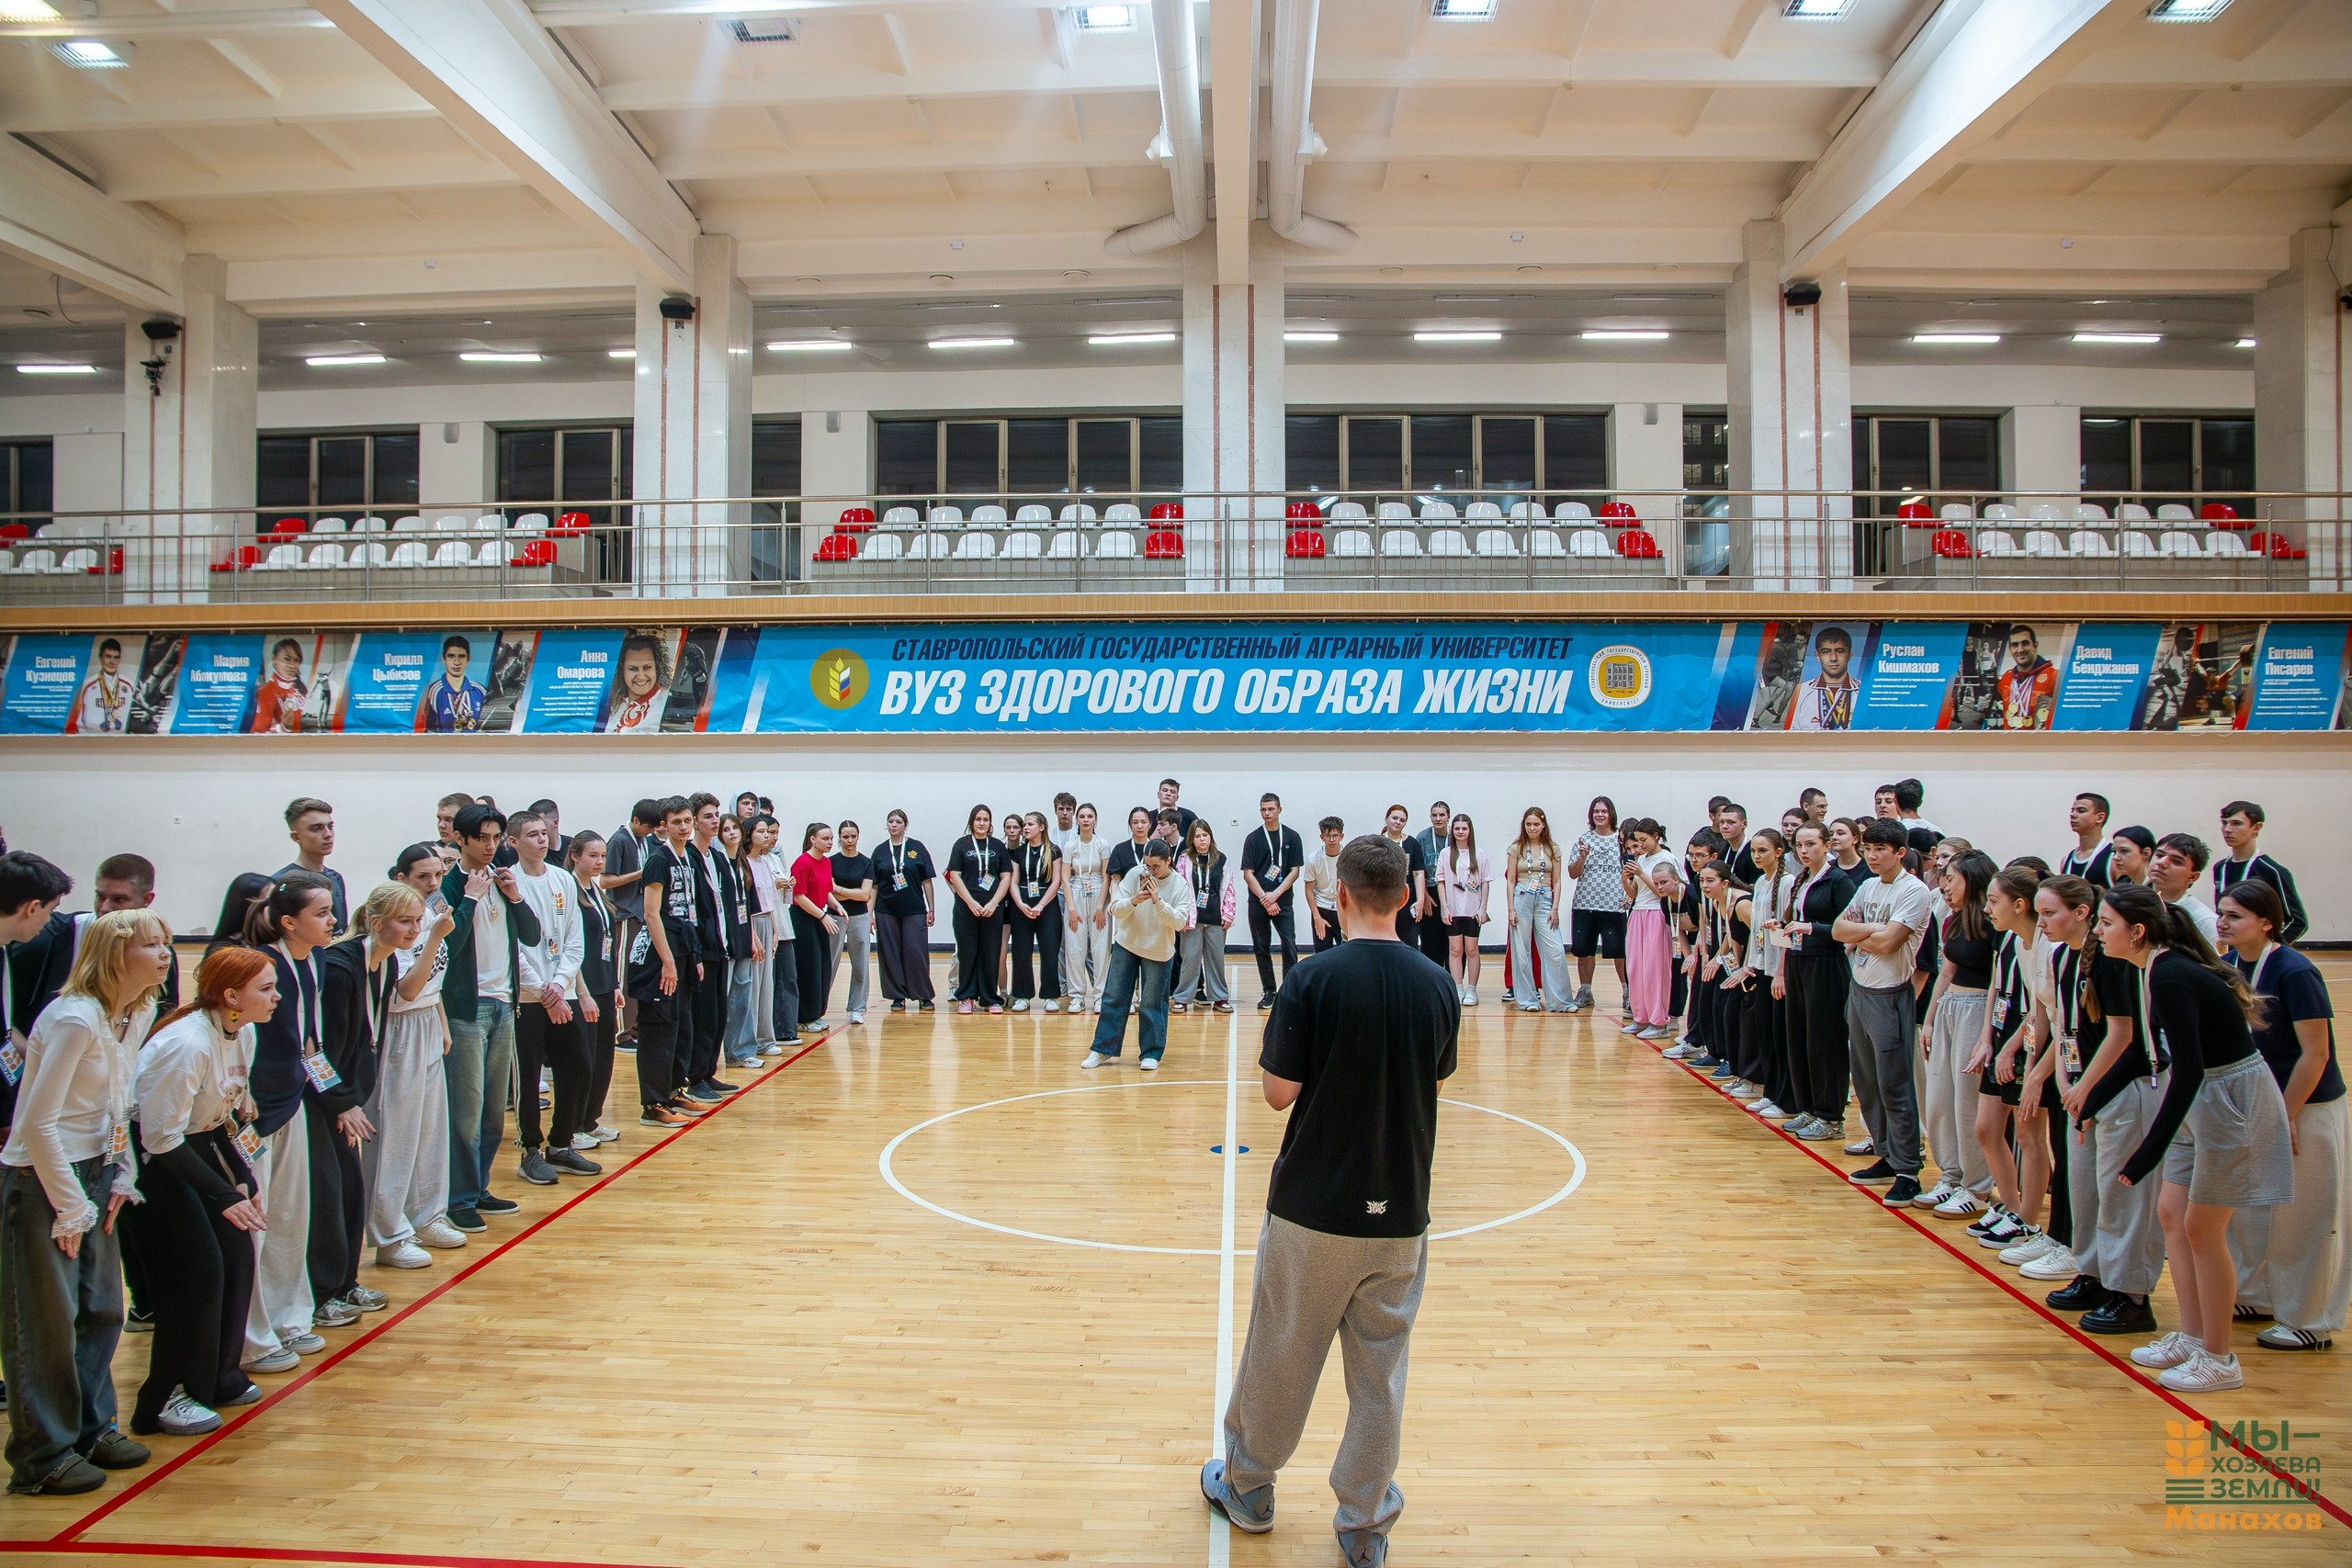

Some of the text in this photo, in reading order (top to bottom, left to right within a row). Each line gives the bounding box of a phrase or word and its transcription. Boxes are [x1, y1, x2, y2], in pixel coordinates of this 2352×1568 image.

[892, 631, 1573, 662] СТАВРОПОЛЬСКИЙ ГОСУДАРСТВЕННЫЙ АГРАРНЫЙ УНИВЕРСИТЕТ
[1883, 643, 1925, 658] Руслан
[2075, 645, 2112, 660] Давид
[2267, 646, 2313, 660] Евгений
[35, 655, 76, 669] Евгений
[213, 654, 250, 669] Мария
[384, 653, 424, 667] Кирилл
[581, 649, 608, 663] Анна
[557, 666, 605, 680] Омарова
[1878, 660, 1940, 673] Кишмахов
[2072, 661, 2140, 676] Бенджанян
[2265, 662, 2314, 677] Писарев
[25, 669, 76, 683] Кузнецов
[190, 669, 248, 683] Абакумова
[372, 668, 421, 682] Цыбизов
[879, 668, 1574, 723] ВУЗ ЗДОРОВОГО ОБРАЗА ЖИЗНИ
